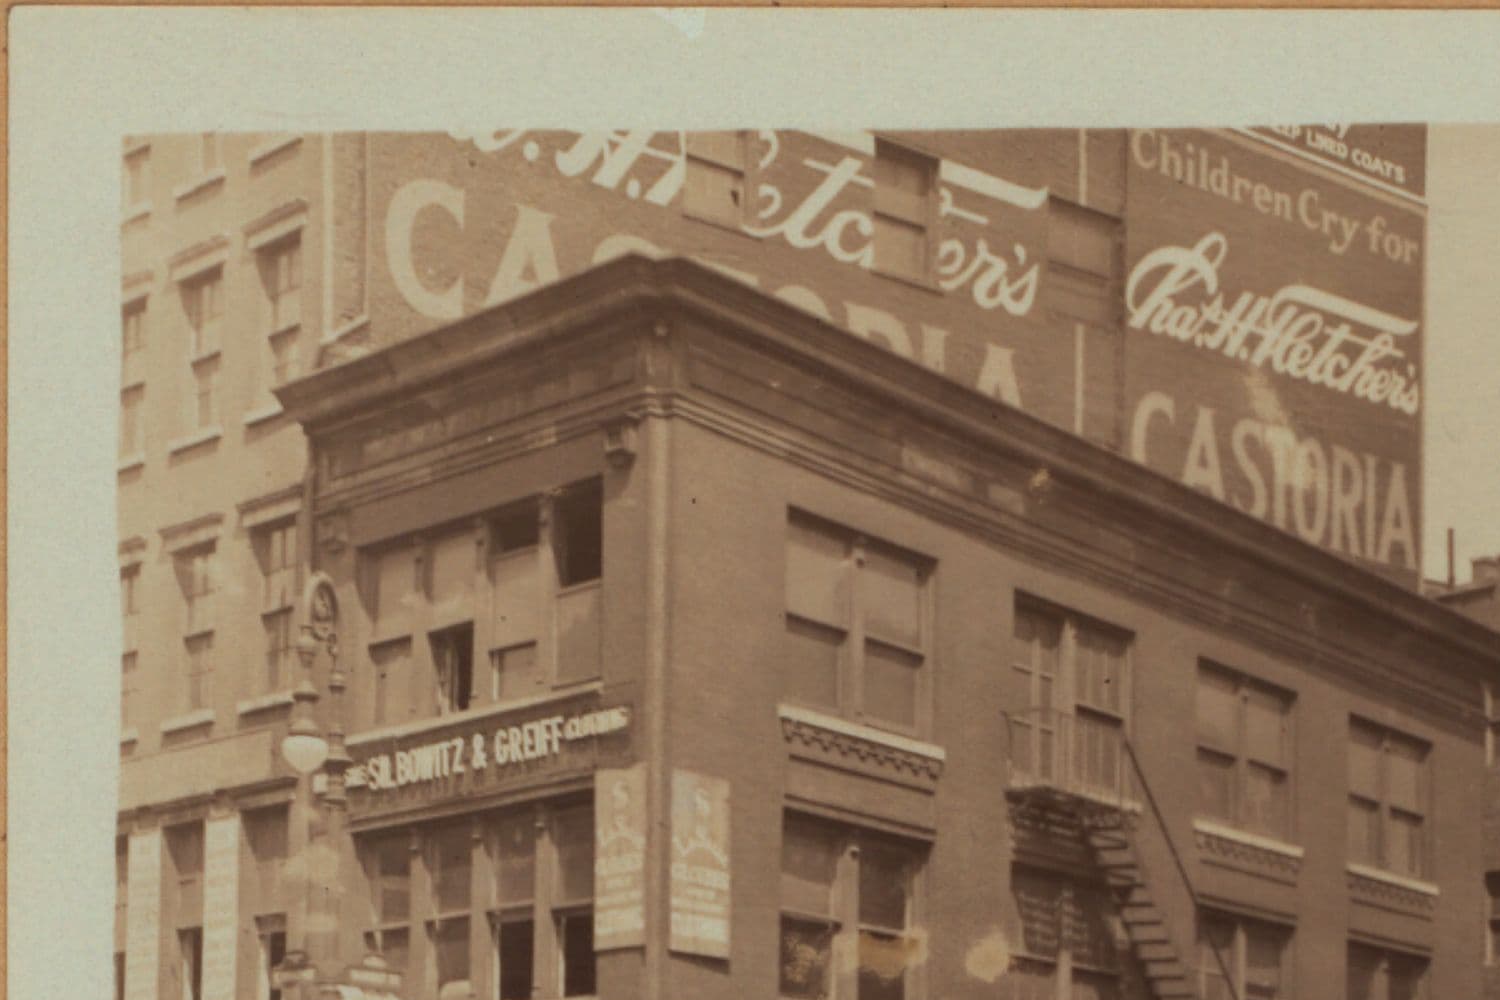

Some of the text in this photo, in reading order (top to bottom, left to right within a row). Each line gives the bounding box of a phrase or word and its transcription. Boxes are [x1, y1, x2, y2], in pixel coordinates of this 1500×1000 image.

[1131, 127, 1419, 264] Children Cry for
[1305, 127, 1349, 161] LINED
[1351, 147, 1406, 184] COATS
[1252, 283, 1420, 416] Fletcher's
[1131, 391, 1417, 571] CASTORIA
[367, 737, 465, 791] SILBOWITZ
[471, 733, 488, 769] &
[494, 715, 565, 766] GREIFF
